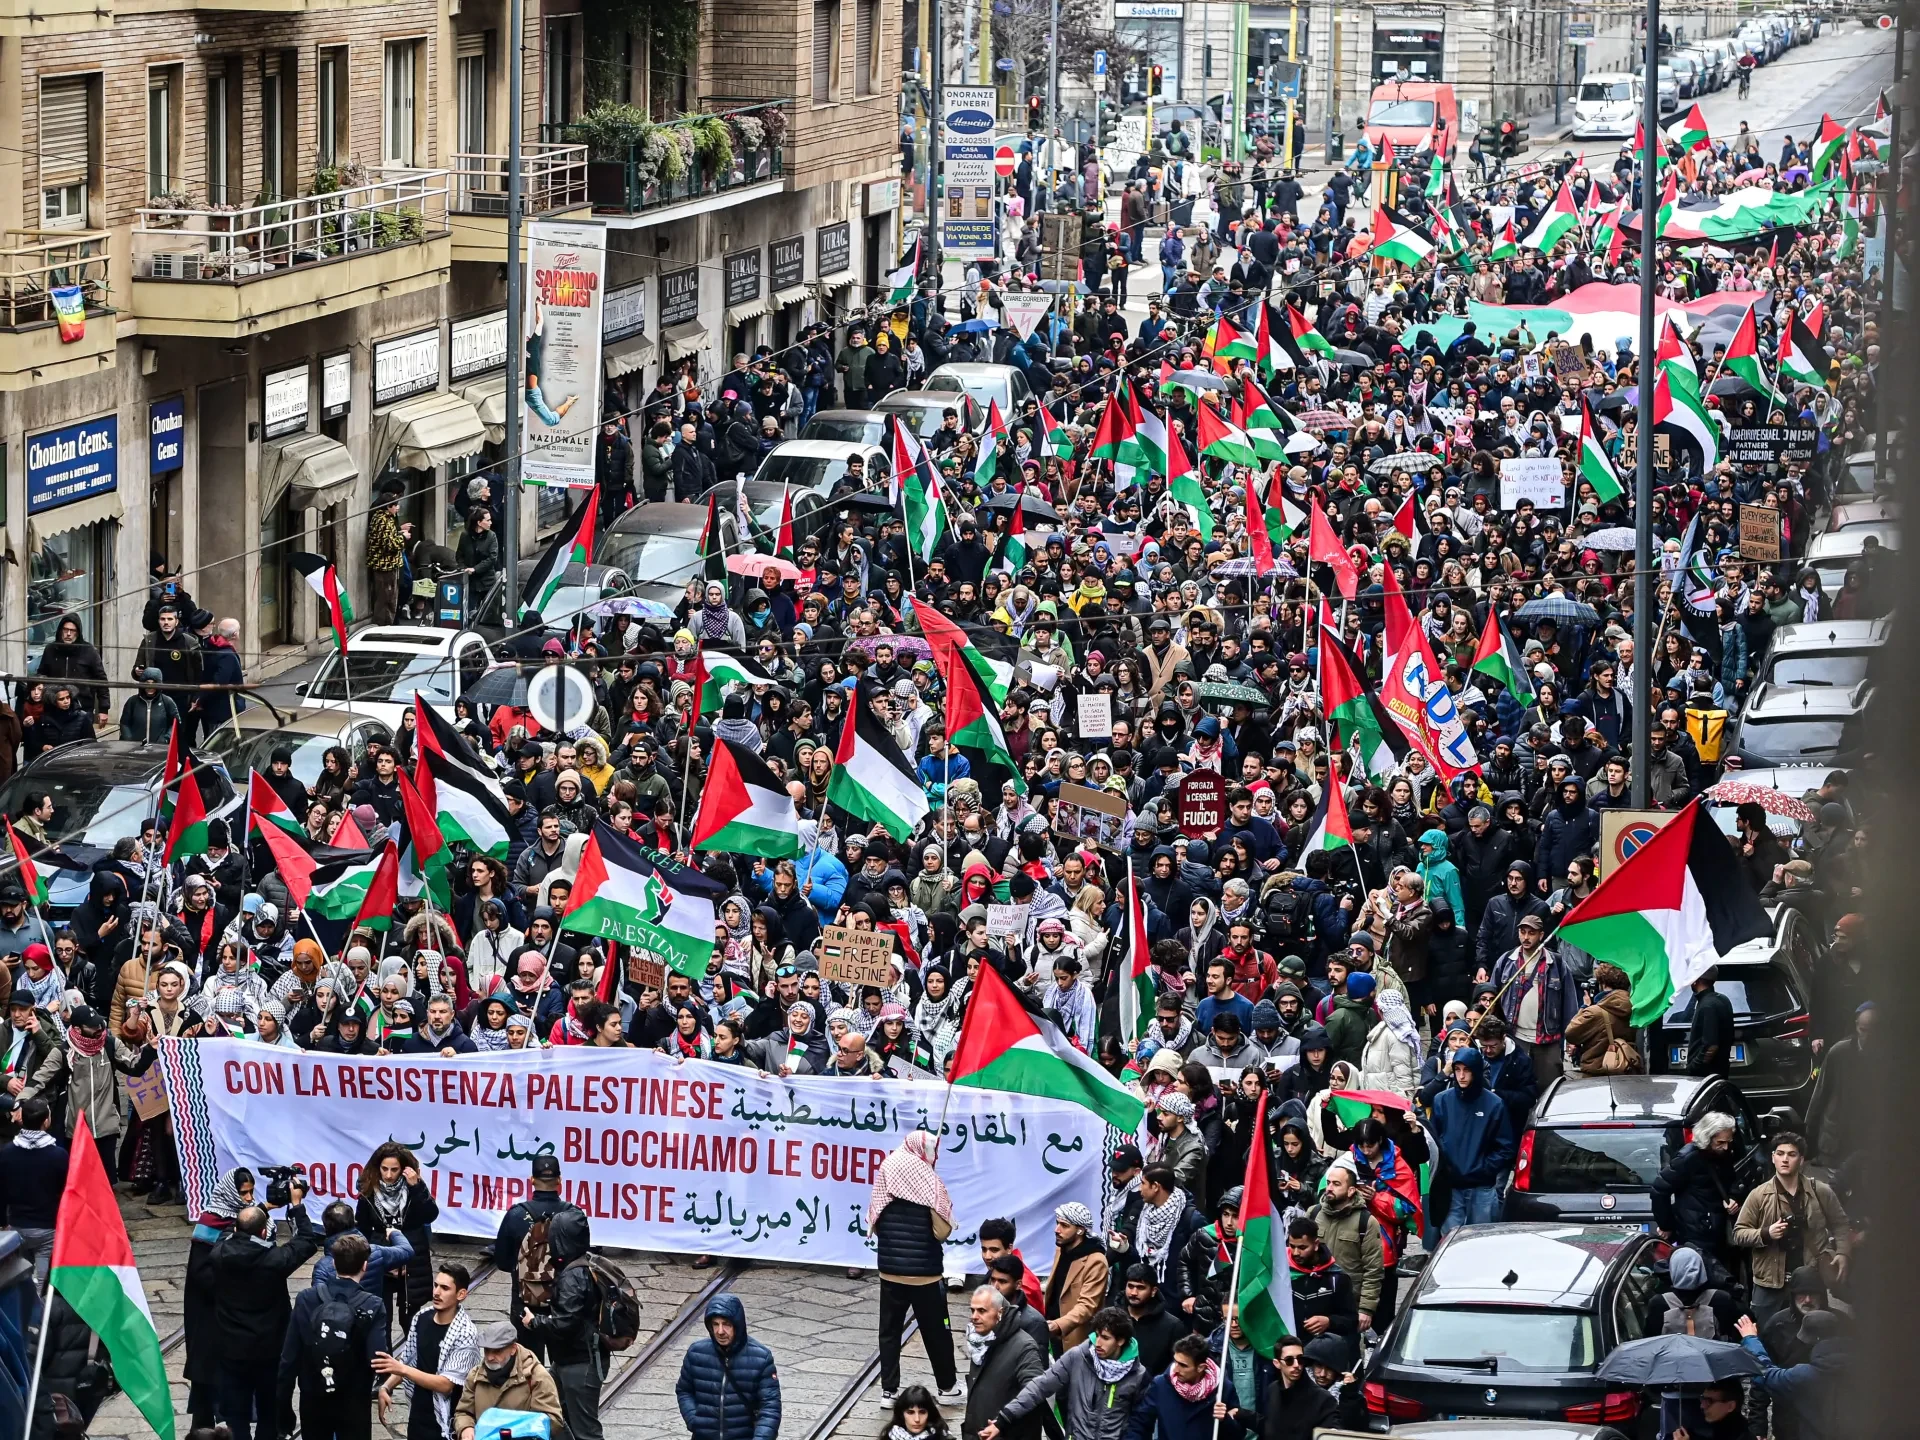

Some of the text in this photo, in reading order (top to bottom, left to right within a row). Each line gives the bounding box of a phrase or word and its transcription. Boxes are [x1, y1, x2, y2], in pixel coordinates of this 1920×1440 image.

[946, 91, 994, 99] ONORANZE
[951, 168, 988, 177] quando
[957, 161, 984, 169] Vicini
[823, 228, 846, 252] TURAG
[775, 242, 800, 266] TURAG
[730, 255, 756, 280] TURAG
[535, 269, 598, 291] SARANNO
[665, 271, 695, 298] TURAG
[541, 287, 591, 308] FAMOSI
[151, 412, 183, 435] Chouhan
[29, 430, 109, 471] Chouhan Gems
[529, 433, 590, 446] NAZIONALE
[1627, 435, 1660, 449] FE
[1735, 441, 1769, 449] PARTNERS
[157, 442, 178, 461] Gems
[1729, 450, 1775, 461] IN GENOCIDE
[45, 471, 69, 486] INGROSSO
[74, 462, 99, 477] DETTAGLIO
[32, 473, 112, 504] GIOIELLI PIETRE DURE ARGENTO
[1741, 508, 1779, 525] EVERY PERSON
[1741, 523, 1774, 536] KILLED WAS
[447, 586, 457, 601] P
[1388, 697, 1420, 723] REDDITO
[1191, 792, 1219, 801] CESSATE
[1198, 781, 1214, 790] GAZA
[1199, 802, 1205, 811] IL
[1183, 810, 1218, 826] FUOCO
[639, 845, 685, 875] FREE
[600, 917, 689, 971] PALESTINE
[825, 929, 891, 949] STOP GENOCIDE
[630, 955, 665, 977] PALESTINE
[842, 946, 880, 965] FREE
[824, 961, 887, 983] PALESTINE
[224, 1060, 725, 1121] CON LA RESISTENZA PALESTINESE
[730, 1087, 1084, 1175] مع المقاومة الفلسطينية
[496, 1133, 556, 1162] ضد
[563, 1126, 893, 1186] BLOCCHIAMO LE GUER
[446, 1170, 677, 1224] E IMPIALISTE
[682, 1189, 831, 1246] الإمبريالية
